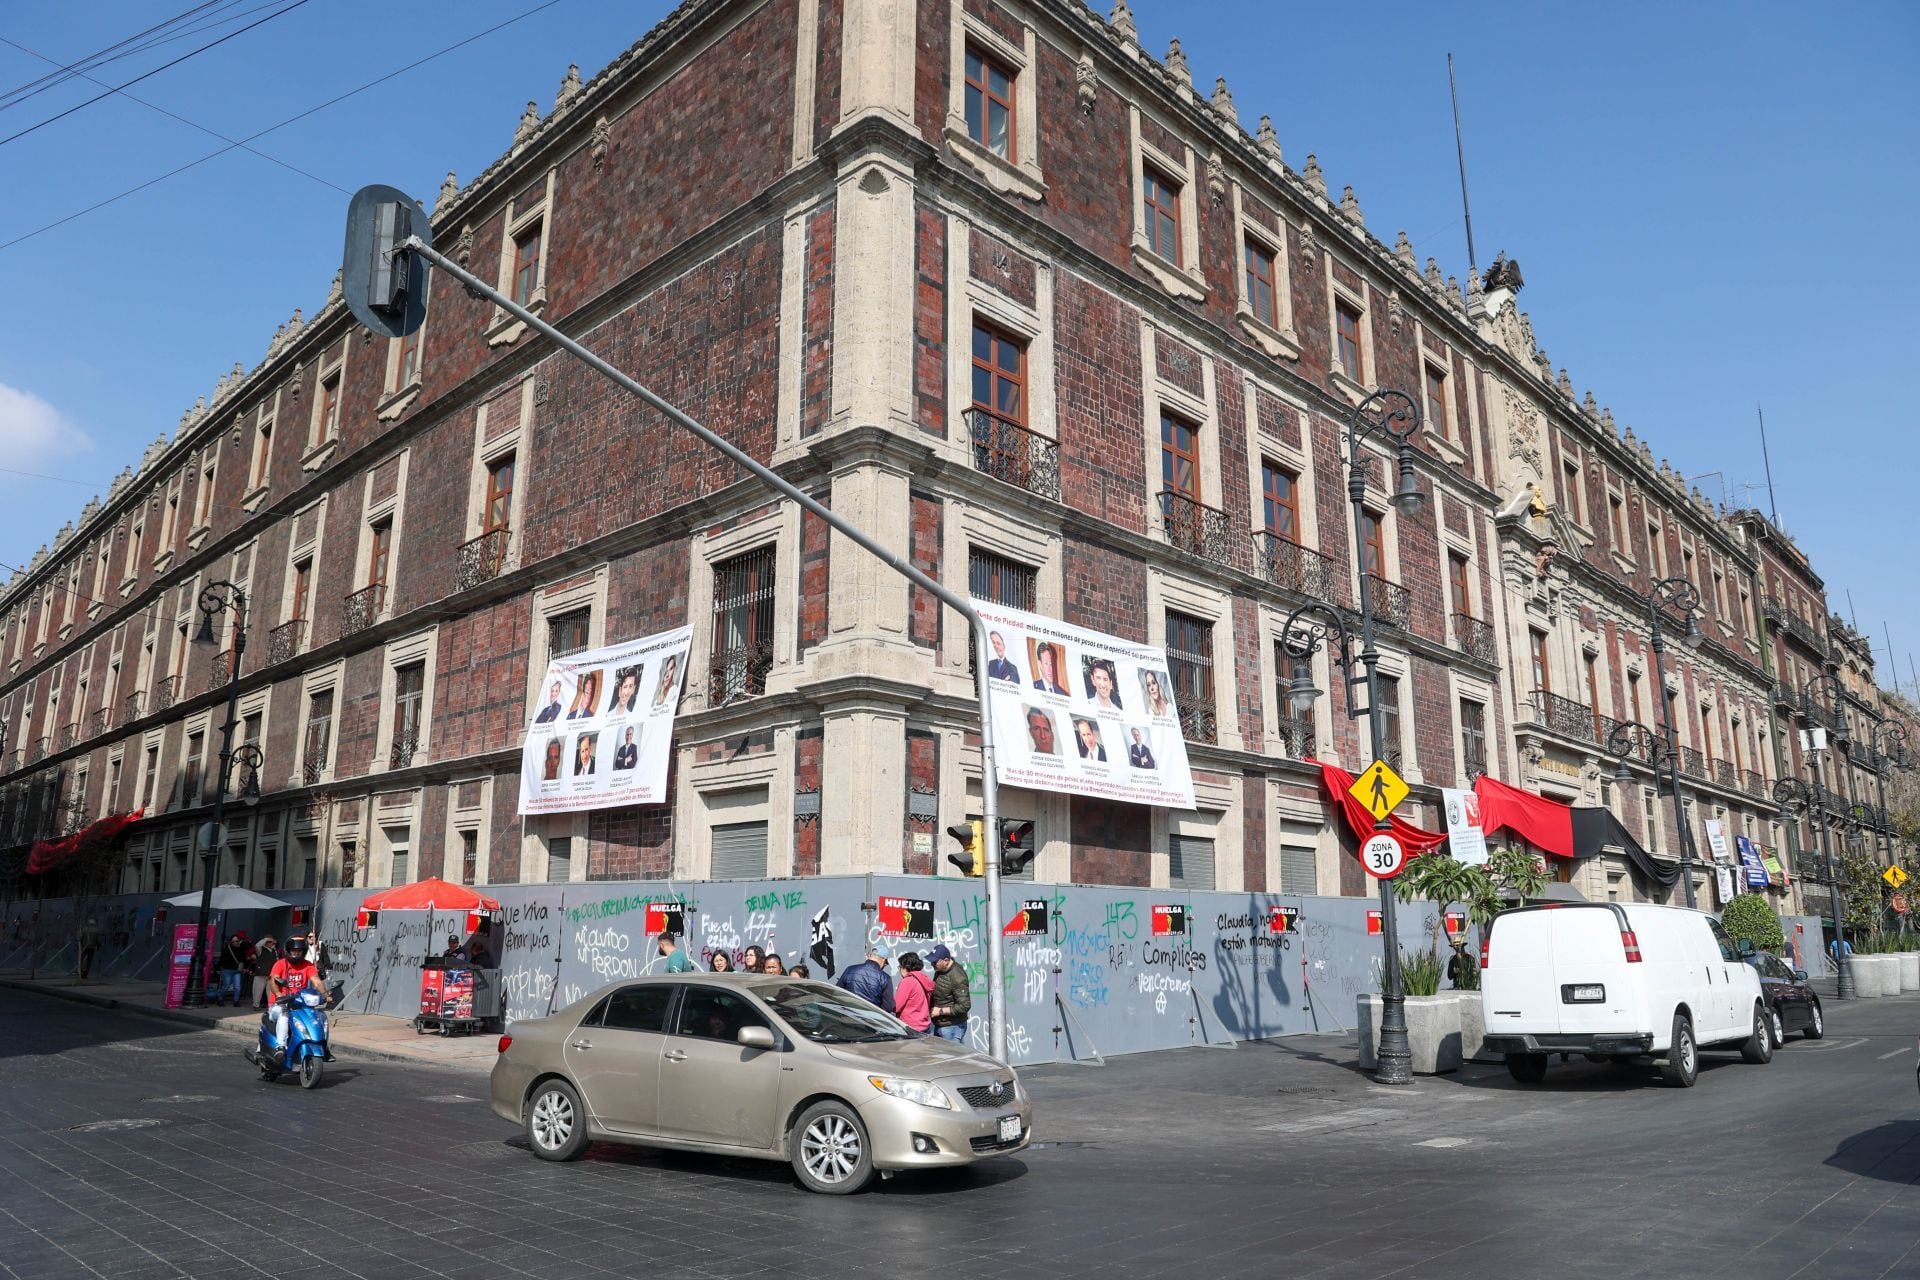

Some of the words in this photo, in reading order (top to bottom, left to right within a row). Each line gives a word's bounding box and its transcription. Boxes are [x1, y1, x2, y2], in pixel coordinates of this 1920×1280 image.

[1371, 843, 1393, 852] ZONA
[1373, 852, 1394, 868] 30
[650, 904, 682, 913] HUELGA
[884, 898, 930, 911] HUELGA
[1155, 906, 1182, 914] HUELGA
[1272, 907, 1296, 915] HUELGA
